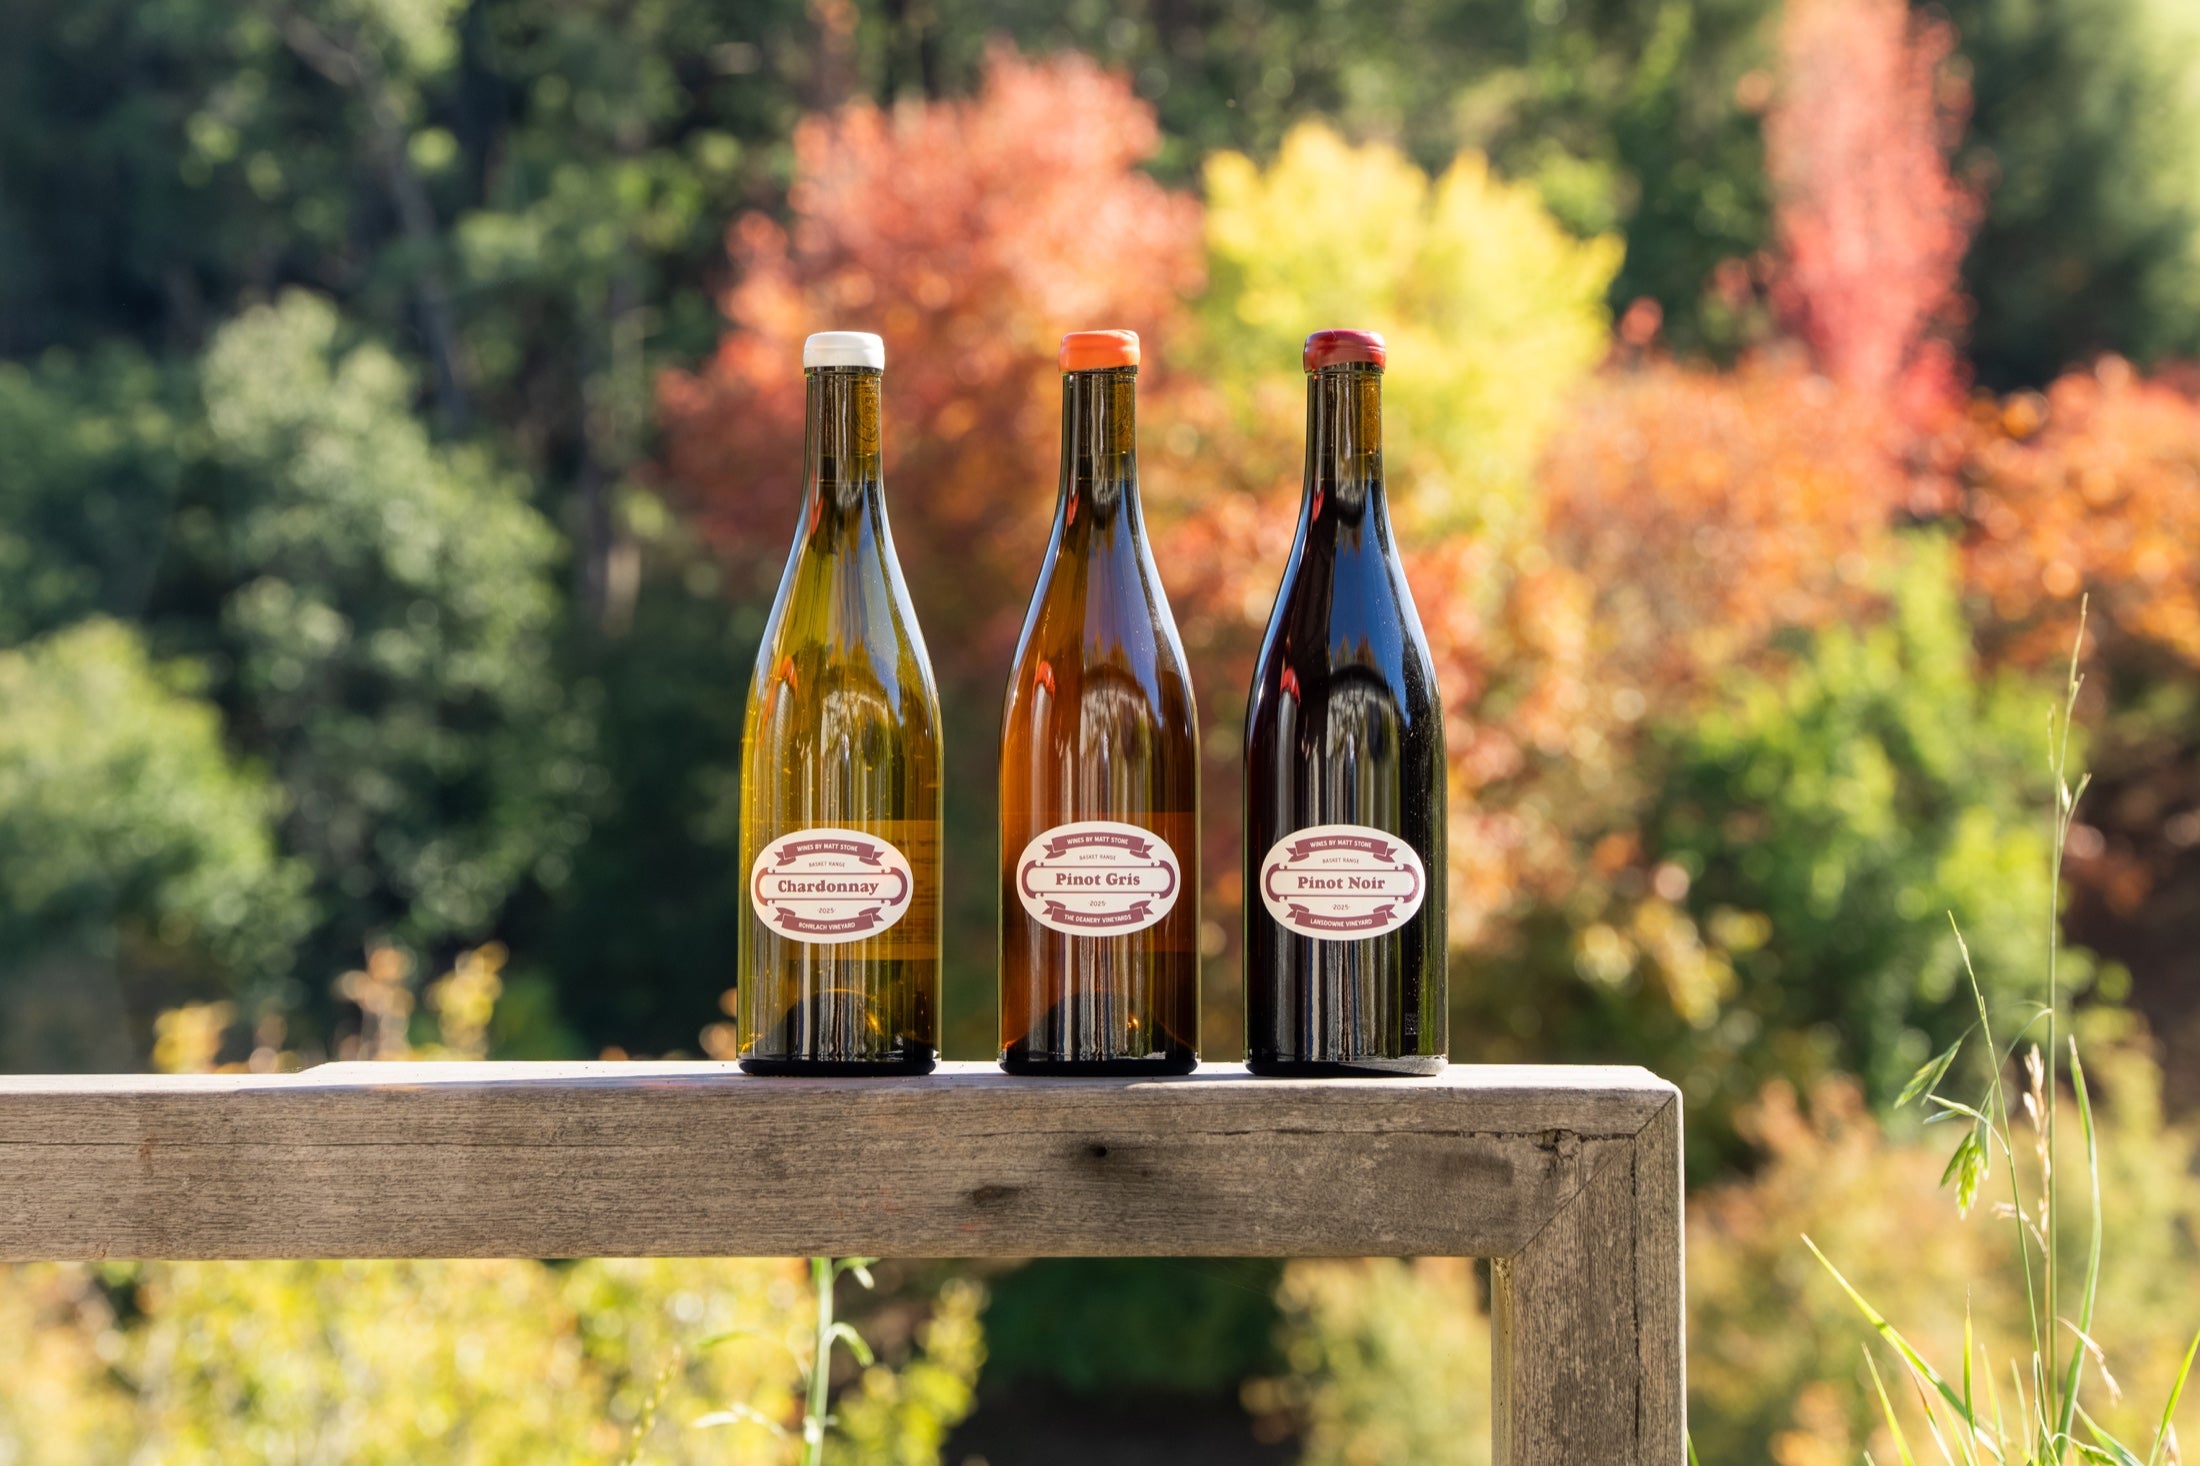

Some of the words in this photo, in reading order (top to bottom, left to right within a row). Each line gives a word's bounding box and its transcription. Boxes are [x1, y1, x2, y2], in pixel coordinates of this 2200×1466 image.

[1067, 837, 1084, 845] WINES
[1111, 837, 1128, 845] STONE
[1310, 840, 1327, 848] WINES
[1354, 840, 1372, 848] STONE
[797, 844, 813, 852] WINES
[840, 844, 858, 852] STONE
[1056, 873, 1101, 885] Pinot
[1106, 873, 1140, 885] Gris
[1298, 876, 1343, 889] Pinot
[1348, 876, 1385, 889] Noir
[778, 880, 879, 895] Chardonnay
[1075, 915, 1100, 923] DEANERY
[1102, 914, 1132, 923] VINEYARDS
[1310, 918, 1344, 927] LANSDOWNE
[1346, 919, 1373, 927] VINEYARD
[798, 922, 827, 930] ROHRLACH
[829, 922, 855, 930] VINEYARD
